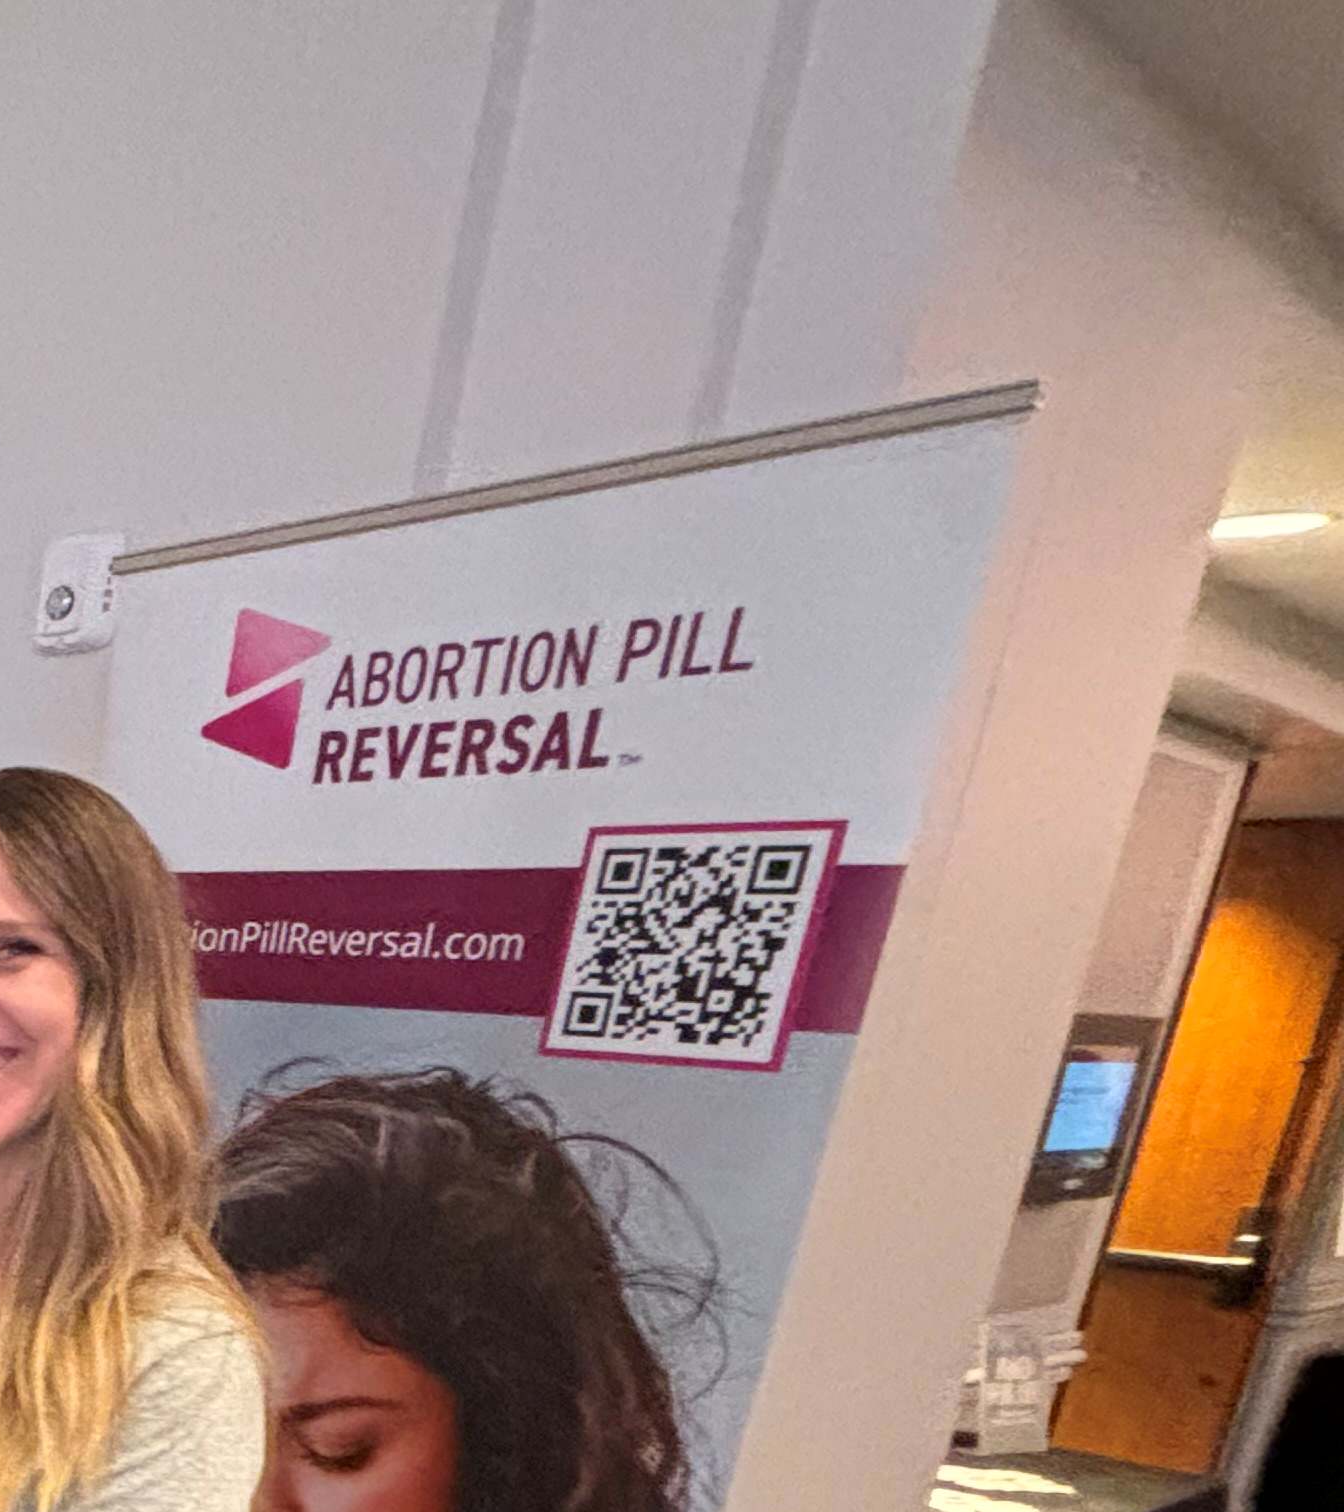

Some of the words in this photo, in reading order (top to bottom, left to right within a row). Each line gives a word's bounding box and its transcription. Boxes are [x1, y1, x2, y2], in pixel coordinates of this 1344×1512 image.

[325, 624, 600, 711] ABORTION
[614, 606, 753, 683] PILL
[312, 708, 610, 784] REVERSAL
